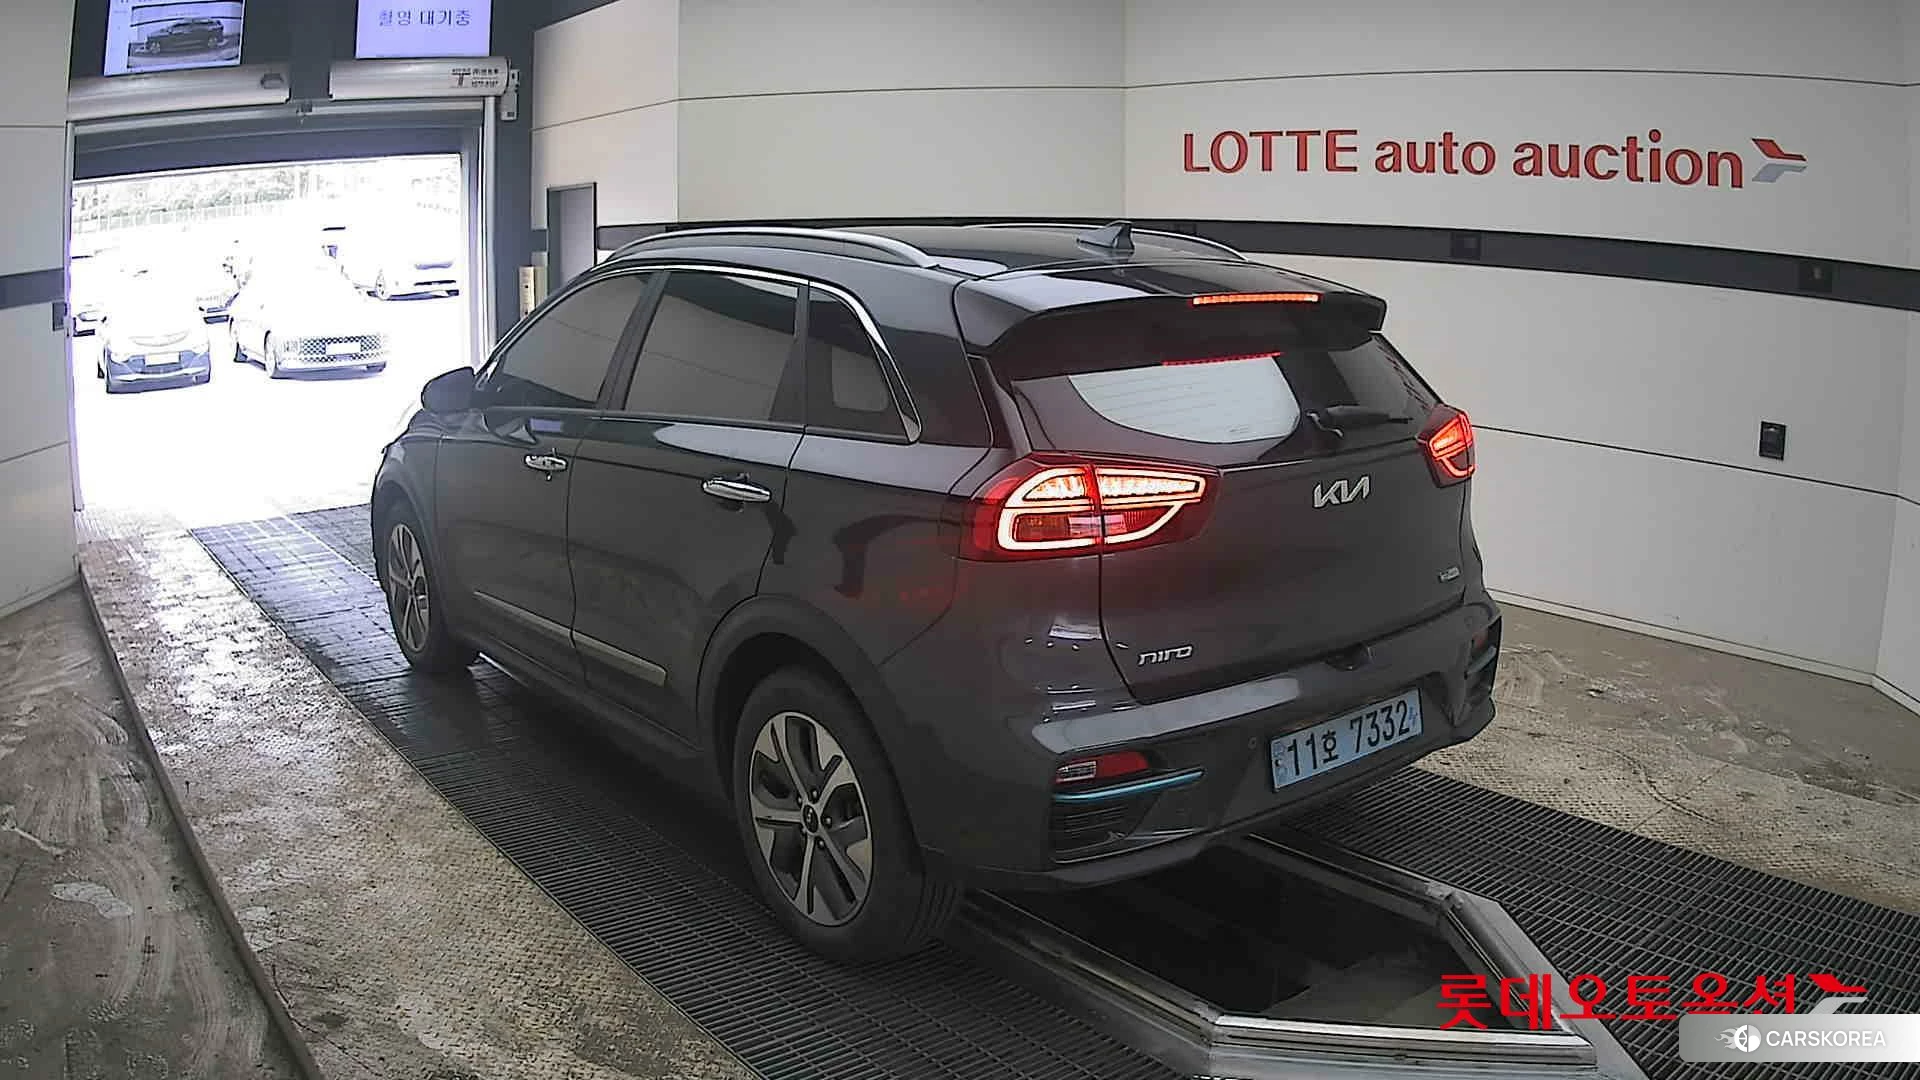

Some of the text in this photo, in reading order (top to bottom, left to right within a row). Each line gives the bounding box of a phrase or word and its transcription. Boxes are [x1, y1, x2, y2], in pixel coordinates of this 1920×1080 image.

[420, 9, 470, 26] 대기중
[1184, 129, 1743, 188] LOTTE auto auction
[1313, 475, 1370, 508] KIA
[1287, 700, 1410, 776] 11호 7332
